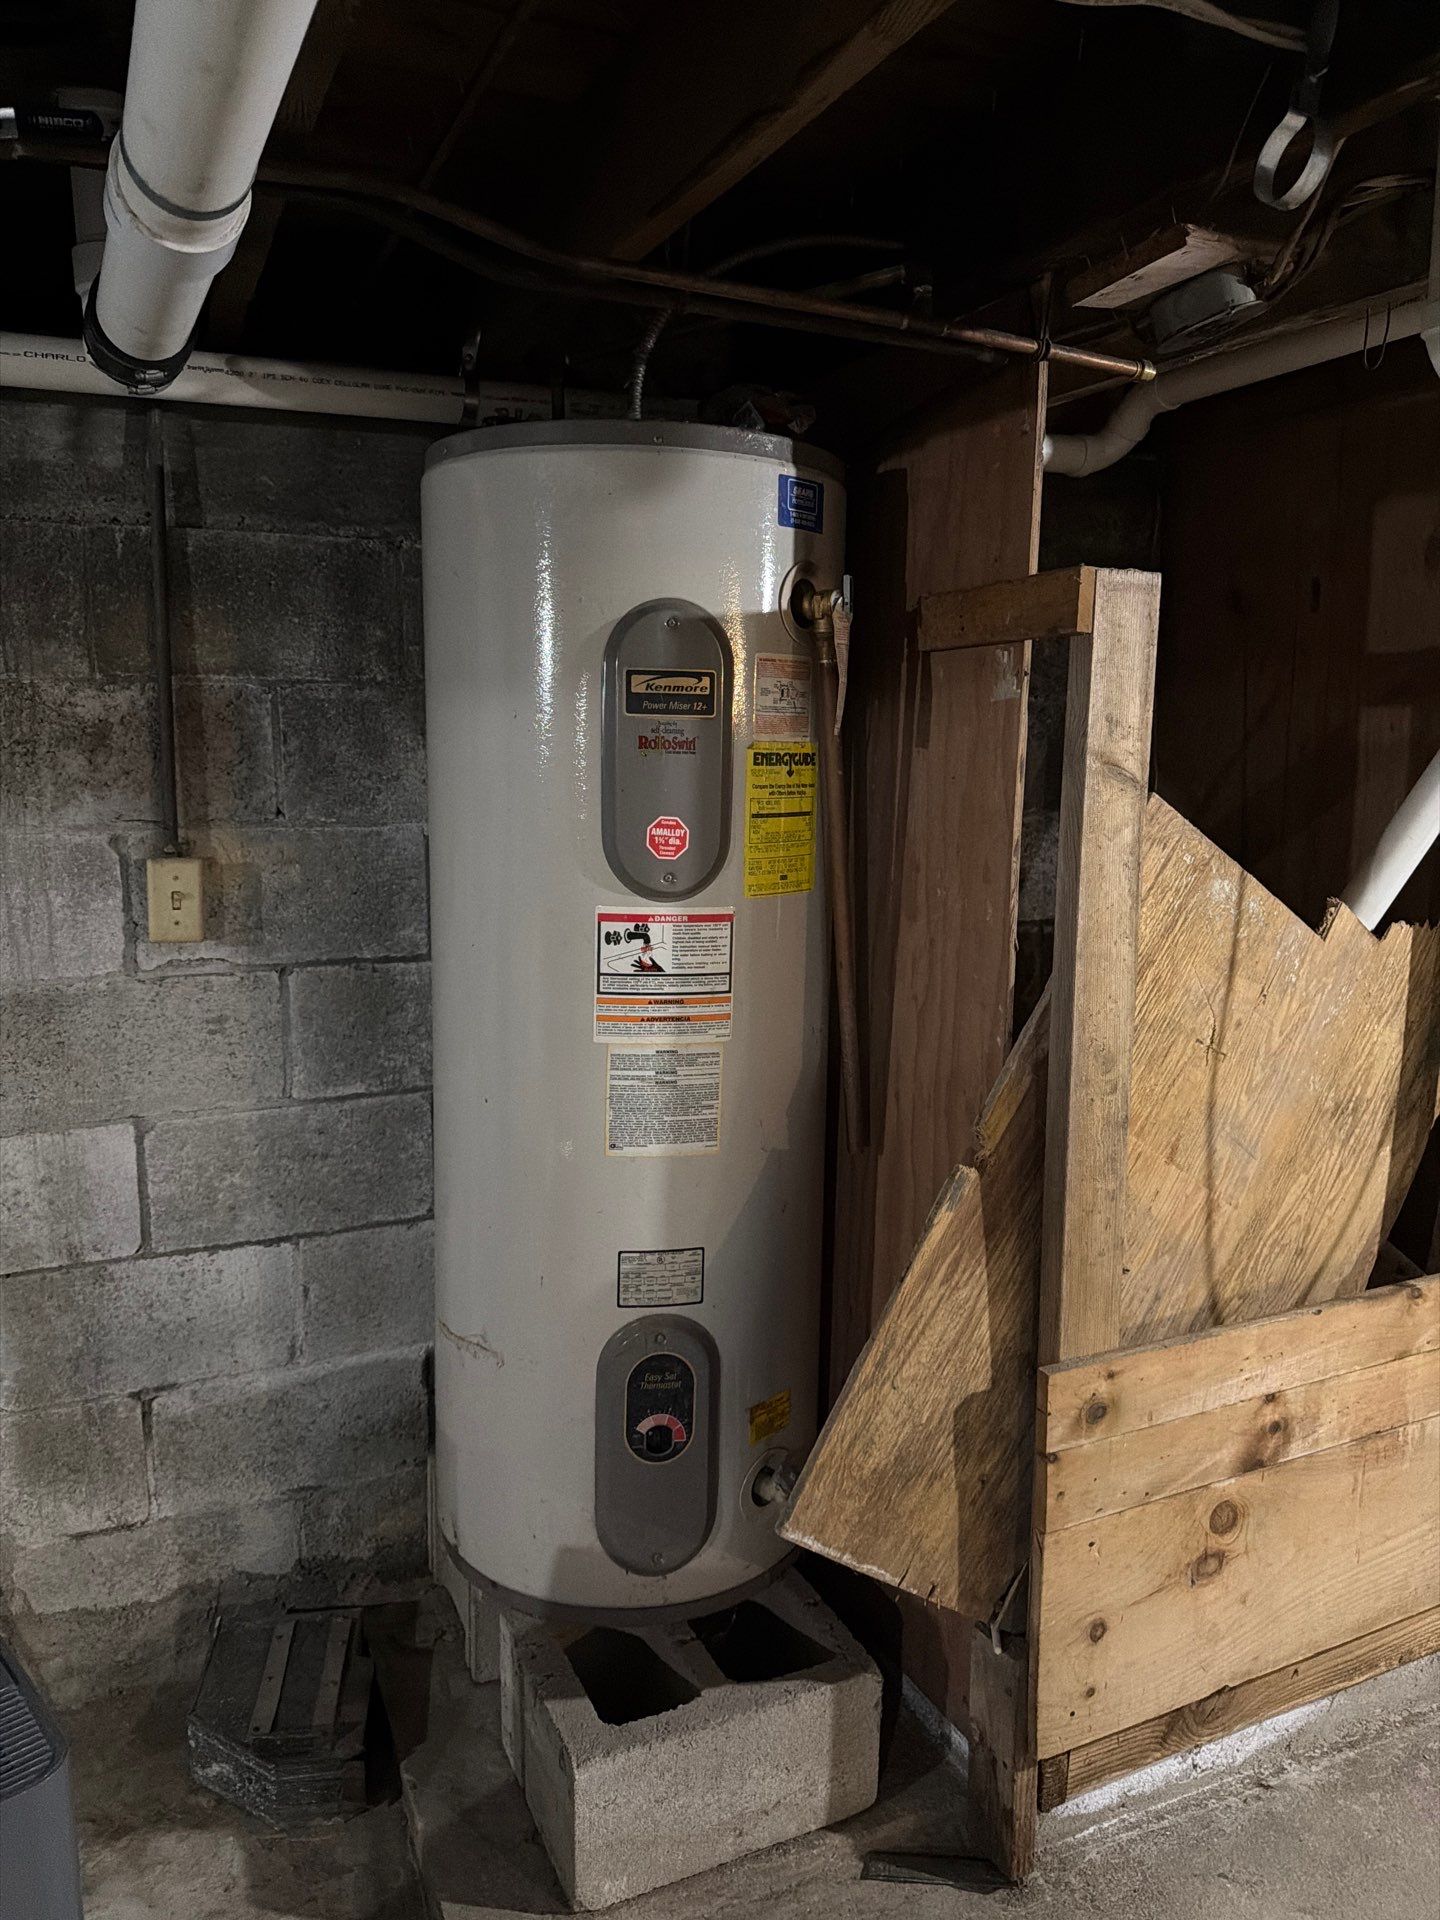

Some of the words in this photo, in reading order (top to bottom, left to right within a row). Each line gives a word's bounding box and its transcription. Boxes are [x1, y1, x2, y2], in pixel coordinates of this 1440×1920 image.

[645, 682, 708, 693] Kenmore
[642, 700, 667, 710] Power
[669, 701, 691, 710] Miser
[693, 702, 708, 711] 12+
[651, 827, 685, 837] AMALLOY
[668, 836, 682, 845] dia.
[644, 1372, 662, 1382] Easy
[664, 1372, 677, 1381] Set
[640, 1380, 682, 1390] Thermostat
